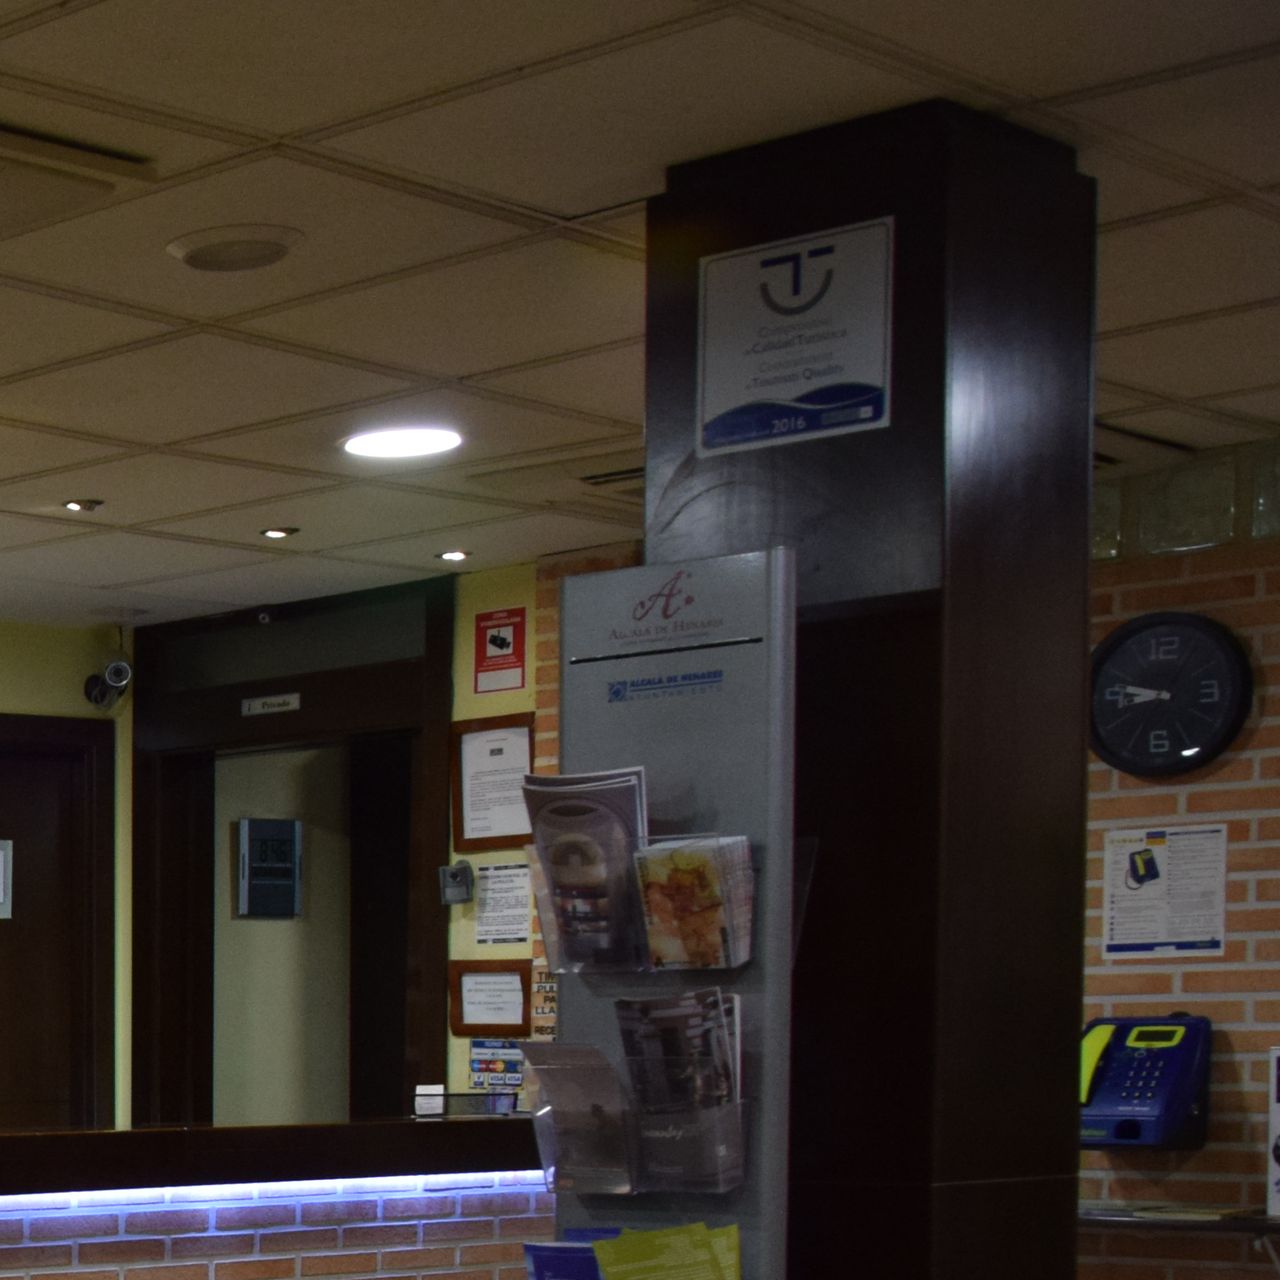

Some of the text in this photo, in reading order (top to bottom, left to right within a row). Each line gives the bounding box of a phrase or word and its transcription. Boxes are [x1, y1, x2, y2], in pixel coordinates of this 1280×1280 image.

[771, 416, 807, 434] 2016
[1149, 636, 1179, 660] 12
[1200, 680, 1220, 703] 3
[1148, 729, 1170, 754] 6
[536, 985, 555, 993] PUL
[535, 1006, 556, 1015] LLA
[534, 1026, 556, 1035] RECE
